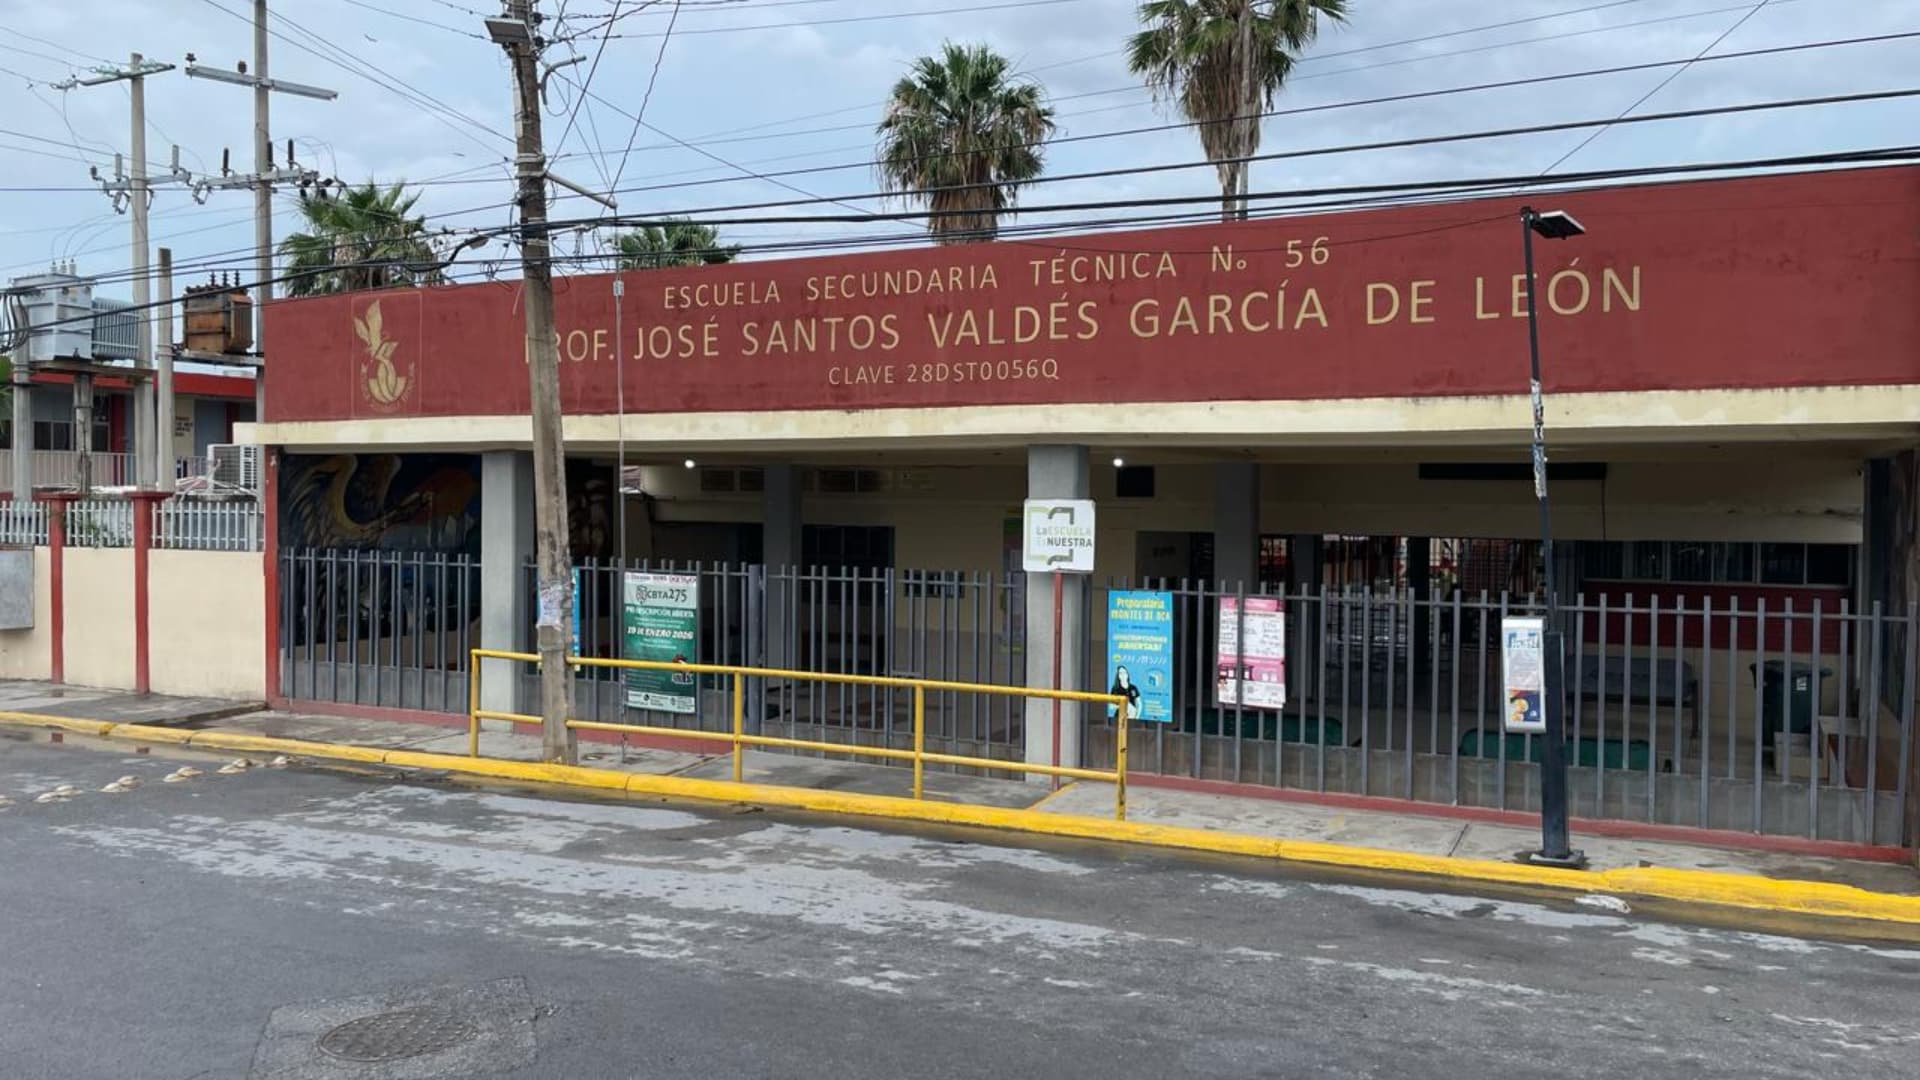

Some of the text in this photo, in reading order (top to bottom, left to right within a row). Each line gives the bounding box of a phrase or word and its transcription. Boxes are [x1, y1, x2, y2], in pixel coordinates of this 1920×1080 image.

[664, 279, 781, 309] ESCUELA
[806, 263, 998, 301] SECUNDARIA
[1029, 248, 1177, 286] TÉCNICA
[1285, 236, 1330, 268] 56
[633, 315, 720, 360] JOSÉ
[741, 313, 900, 356] SANTOS
[927, 292, 1099, 349] VALDÉS
[1129, 278, 1329, 338] GARCÍA
[1366, 280, 1436, 325] DE
[1475, 257, 1641, 320] LEÓN
[828, 358, 1059, 386] CLAVE 28DST0056Q
[1046, 536, 1092, 547] NUESTRA
